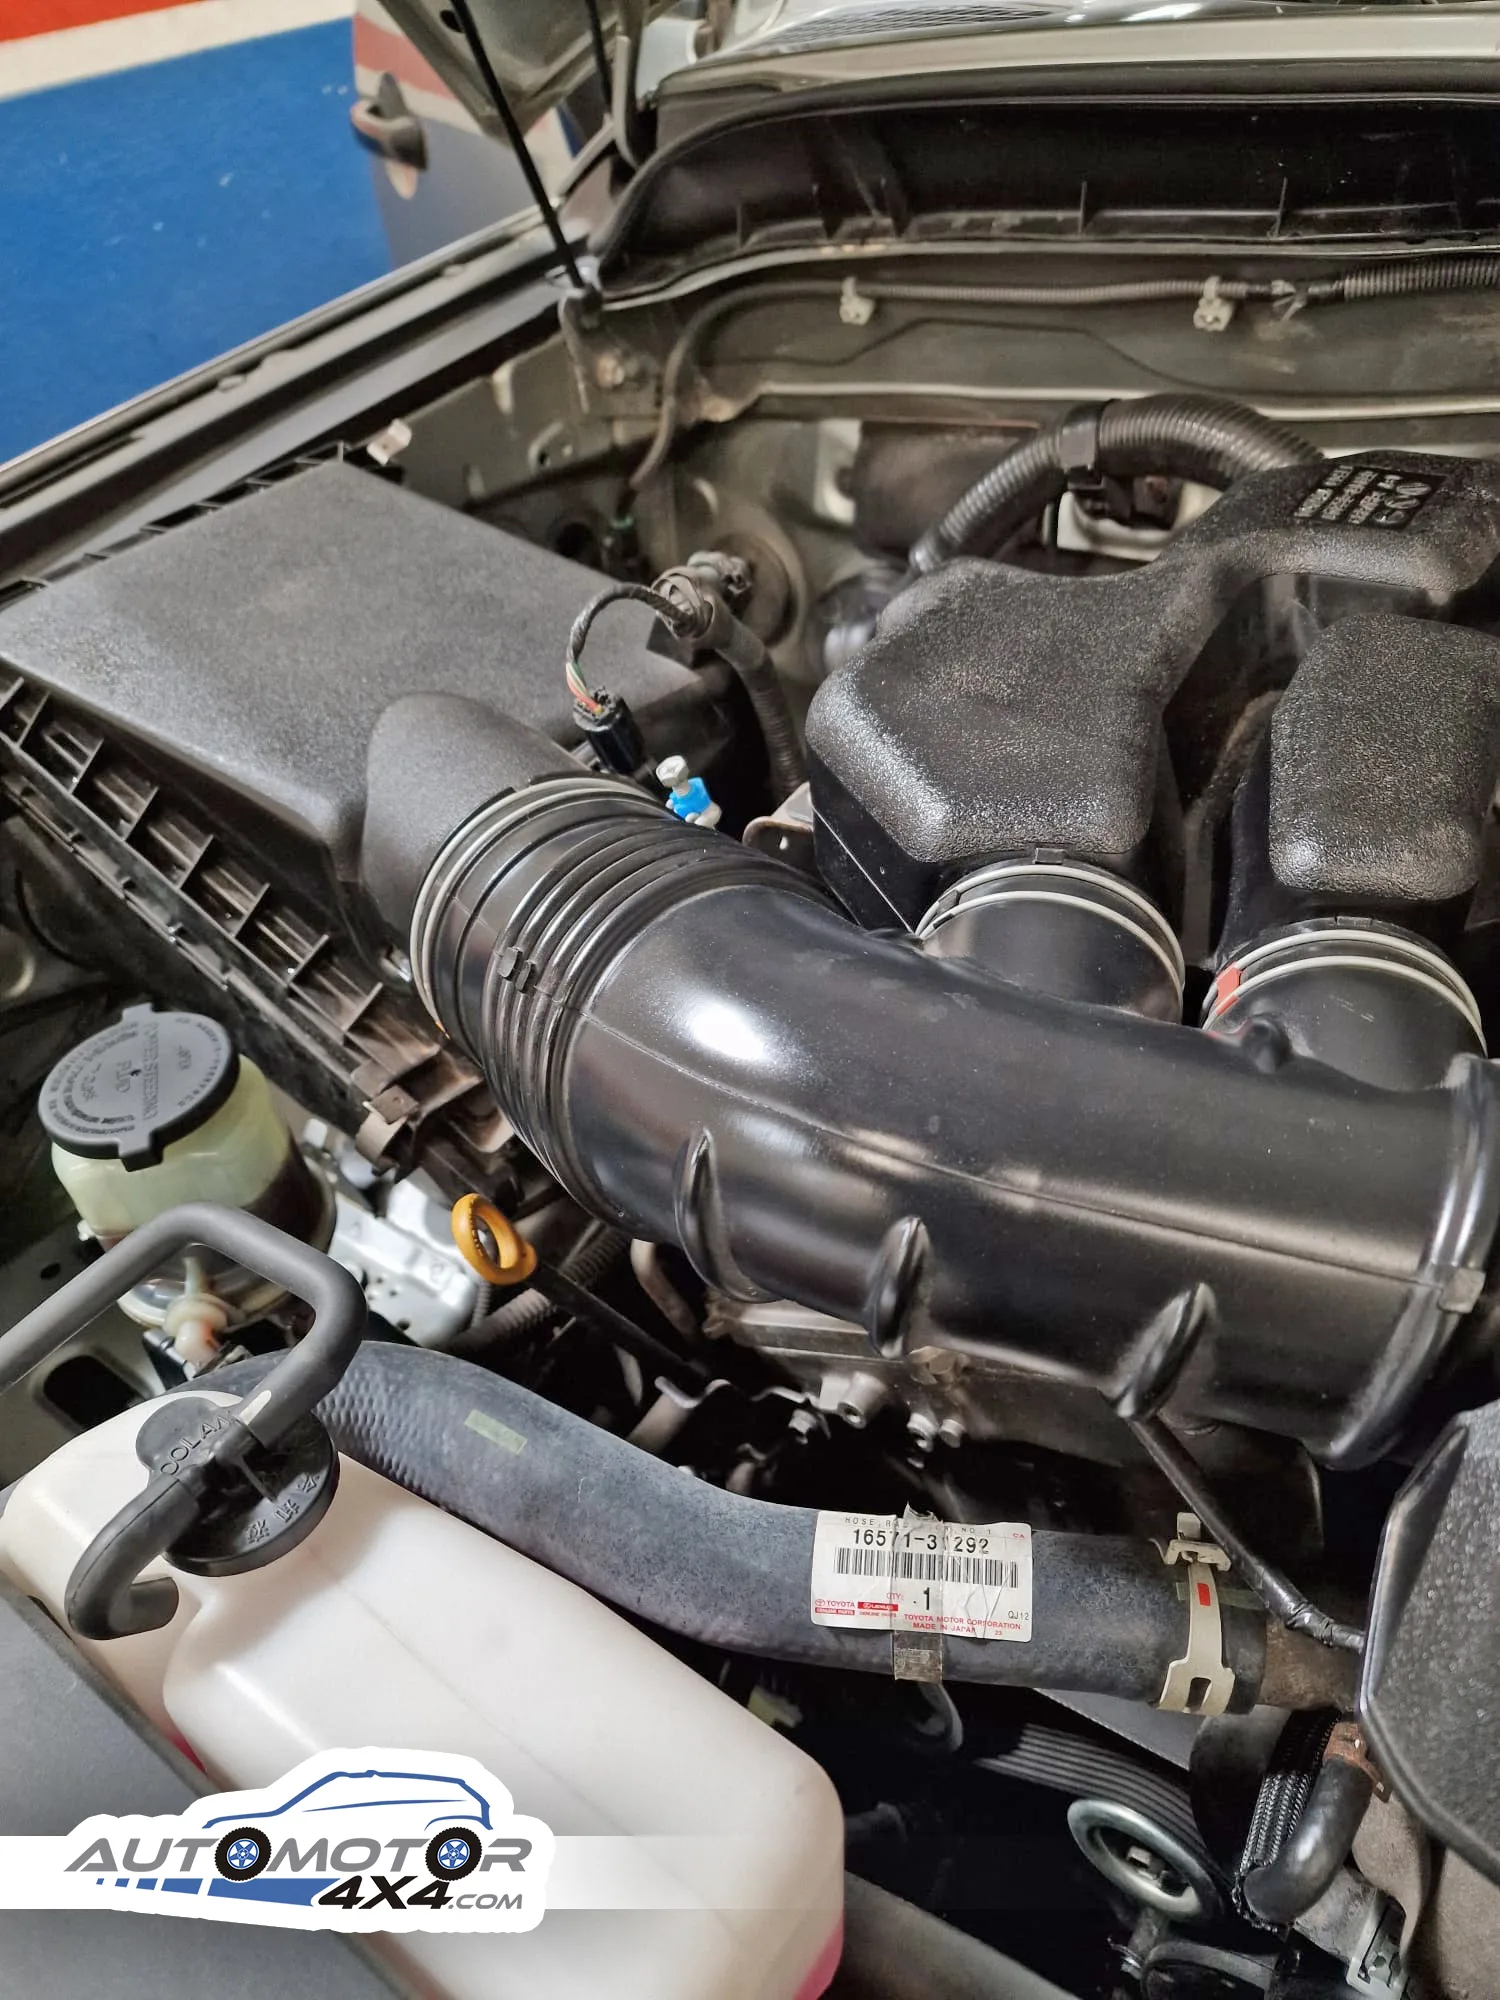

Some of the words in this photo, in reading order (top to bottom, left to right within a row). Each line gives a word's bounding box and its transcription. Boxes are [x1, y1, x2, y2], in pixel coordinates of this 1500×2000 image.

[827, 1600, 855, 1608] TOYOTA
[903, 1613, 934, 1622] TOYOTA
[936, 1616, 964, 1625] MOTOR
[1007, 1610, 1030, 1621] QJ12
[912, 1622, 937, 1630] MADE
